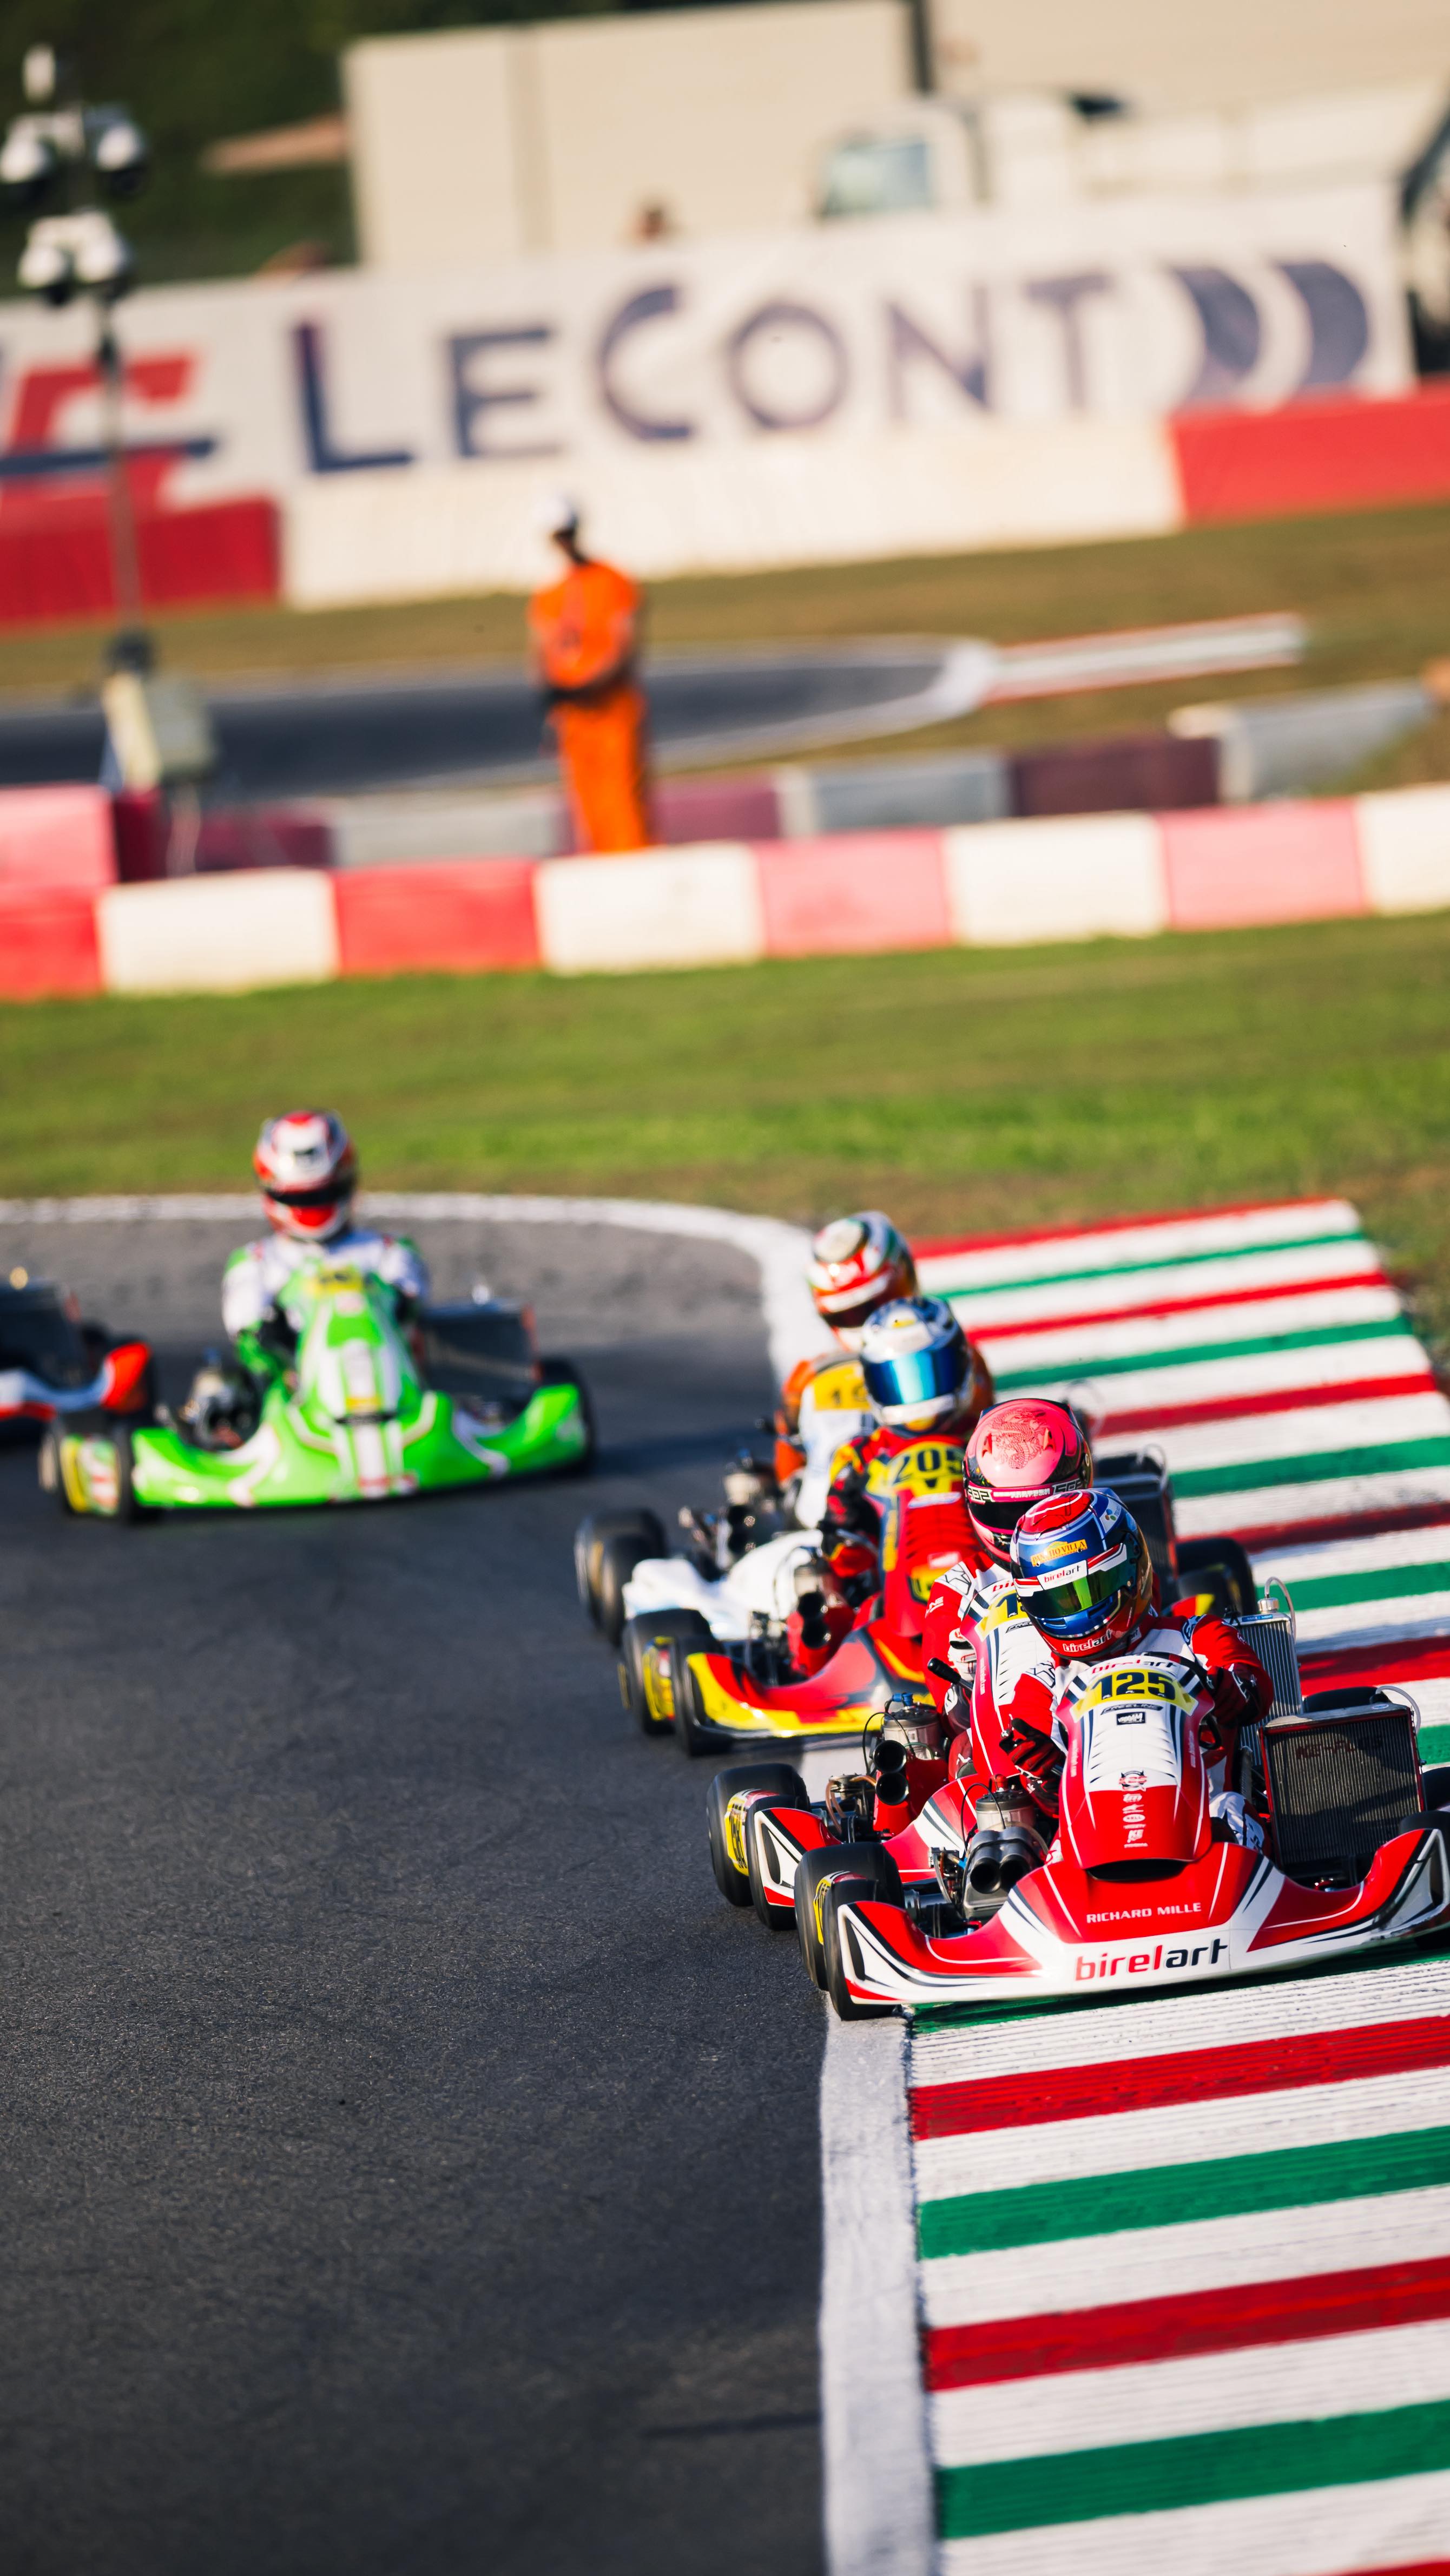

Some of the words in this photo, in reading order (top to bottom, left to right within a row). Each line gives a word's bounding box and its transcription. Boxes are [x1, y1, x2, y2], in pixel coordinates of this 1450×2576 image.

[1060, 1541, 1085, 1554] VILLA
[1044, 1565, 1080, 1583] birelart
[1063, 1629, 1113, 1652] birelart
[1091, 1672, 1176, 1700] 125
[1086, 1908, 1152, 1924] RICHARD
[1157, 1902, 1202, 1915] MILLE
[1075, 1938, 1228, 1981] birelart
